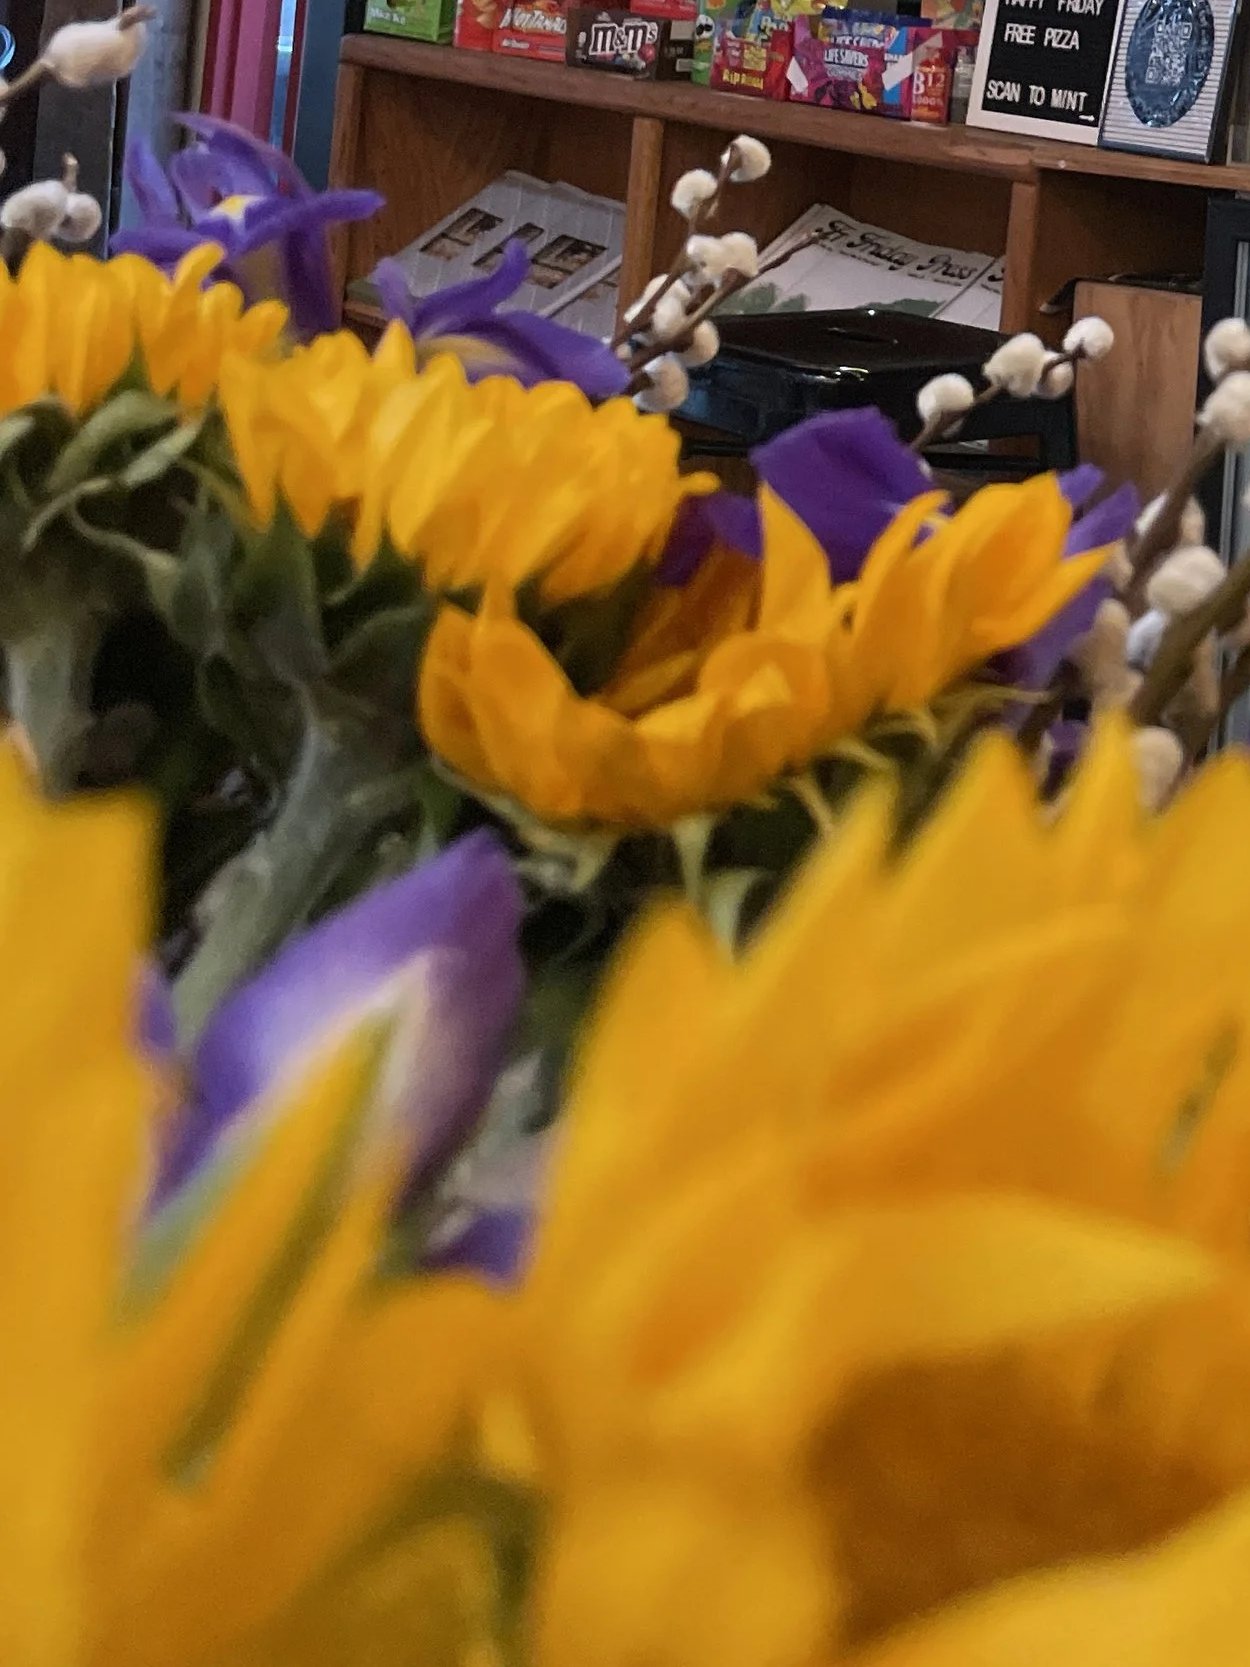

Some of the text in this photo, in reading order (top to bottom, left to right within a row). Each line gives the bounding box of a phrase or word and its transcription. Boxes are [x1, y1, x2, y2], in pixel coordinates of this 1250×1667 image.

[1004, 22, 1080, 50] FREE PIZZA
[913, 70, 945, 96] B12
[986, 79, 1089, 111] SCAN TO MINT
